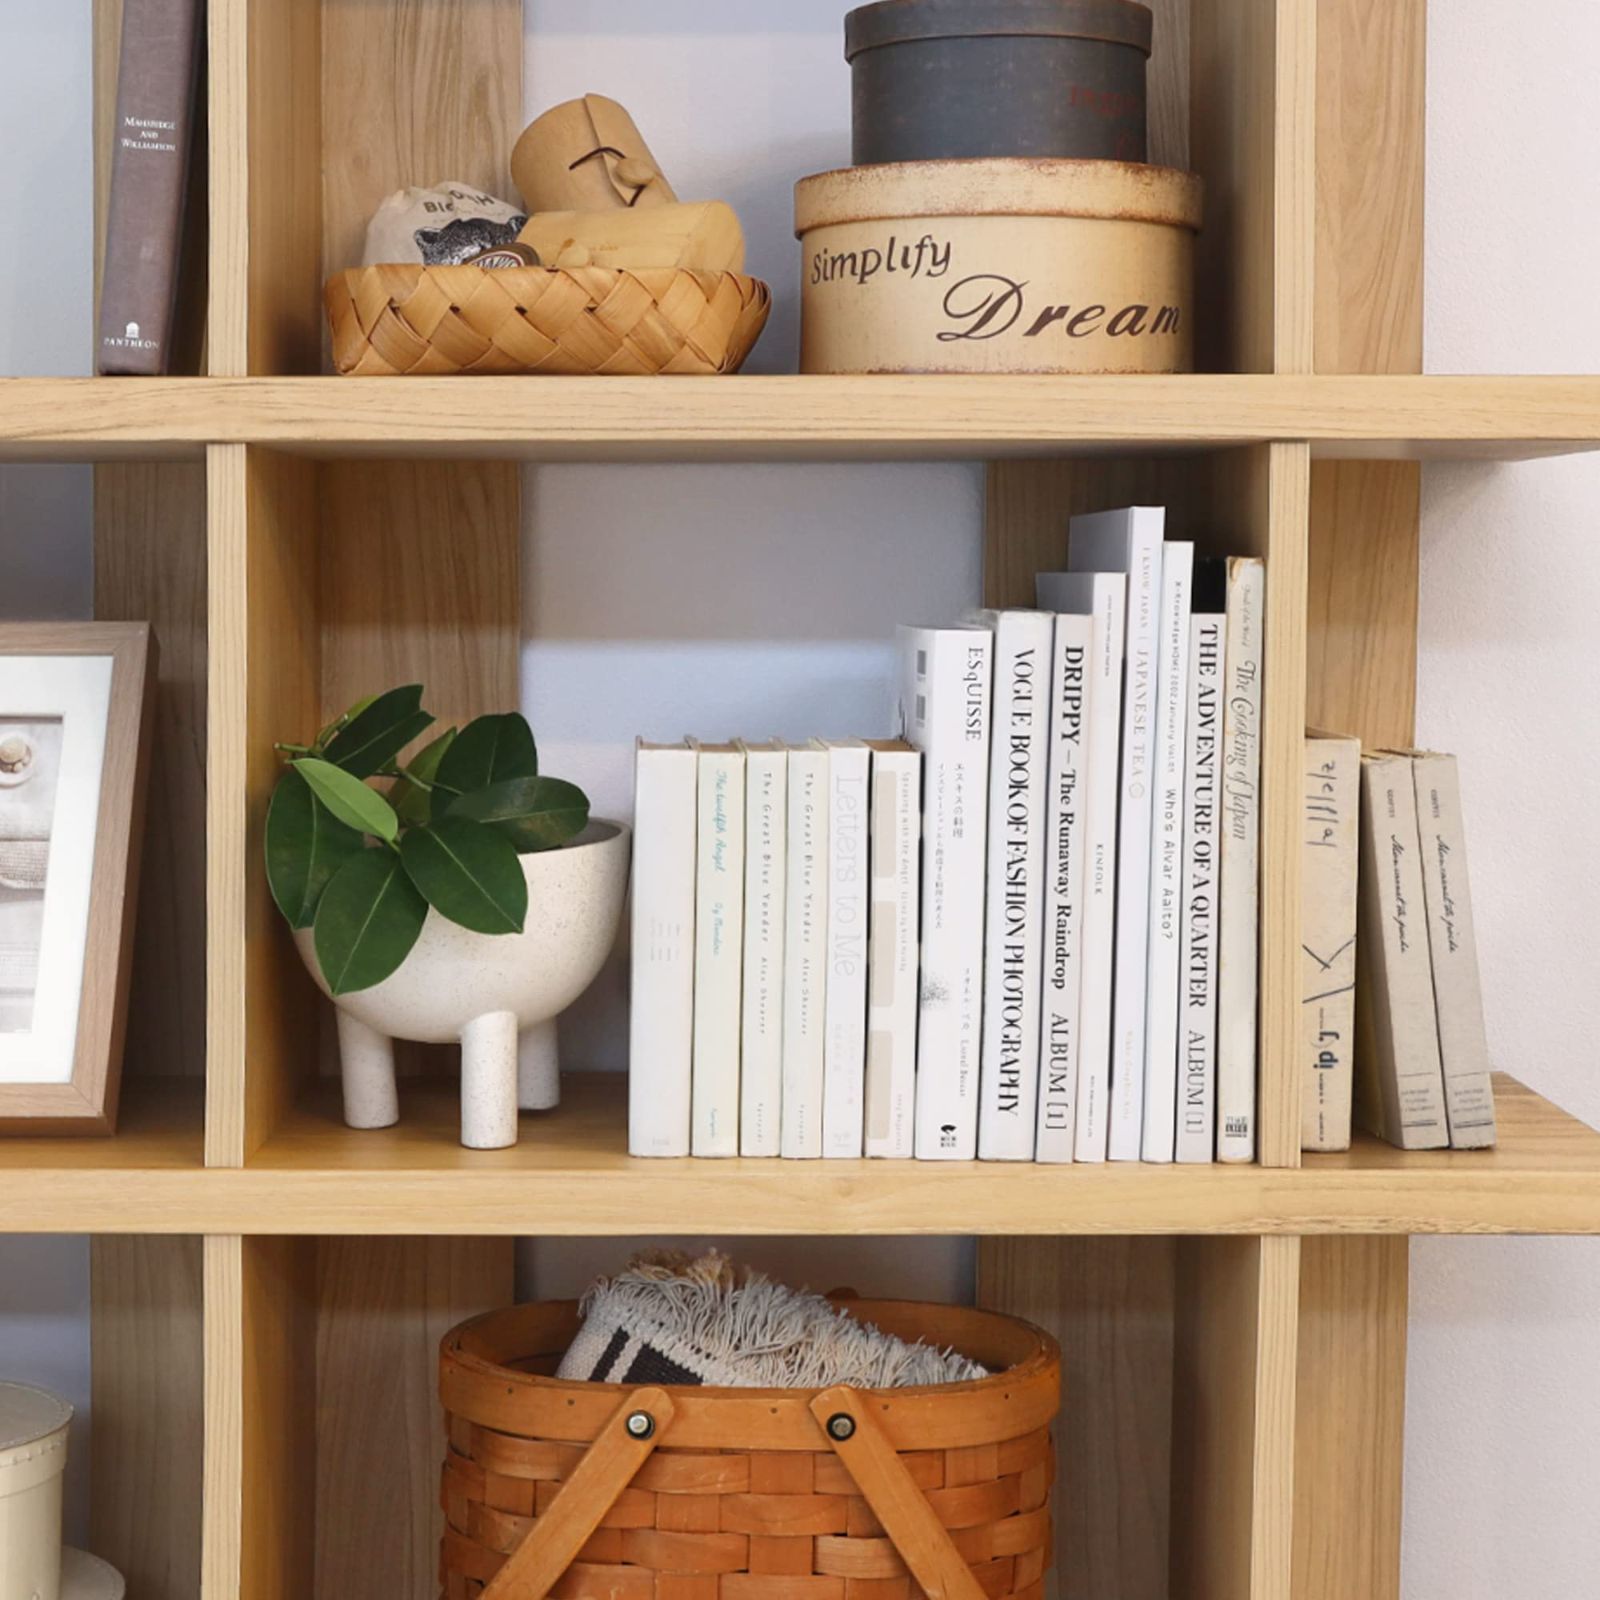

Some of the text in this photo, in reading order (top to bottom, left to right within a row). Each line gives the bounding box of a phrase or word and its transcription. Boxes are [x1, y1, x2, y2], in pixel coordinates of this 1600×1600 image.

[811, 234, 951, 285] Simplify
[936, 273, 1180, 342] Dream
[104, 337, 160, 349] PANTHEON
[1139, 596, 1150, 629] JAPAN
[1141, 556, 1150, 590] KNOW
[963, 647, 984, 742] ESqUISSE
[1061, 646, 1084, 746] DRIPPY
[1130, 650, 1148, 777] JAPANESE TEA
[1060, 769, 1076, 805] The
[1226, 660, 1256, 840] The Cooking of Japan
[712, 838, 727, 872] Angel
[761, 773, 771, 942] The Great Blue Yonder
[803, 773, 813, 943] The Great Blue Yonder
[1054, 812, 1075, 898] Runaway
[1162, 788, 1176, 940] Who's Alvar Aalto?
[1188, 624, 1218, 1008] THE ADVENTURE OF A QUARTER
[833, 775, 862, 976] Letters to Me
[998, 648, 1035, 1116] VOGUE BOOK OF FASHION PHOTOGRAPHY
[1094, 843, 1104, 896] KINFOLK
[1050, 904, 1072, 990] Raindrop
[1046, 1012, 1070, 1130] ALBUM [1]
[1185, 1030, 1206, 1134] ALBUM [1]
